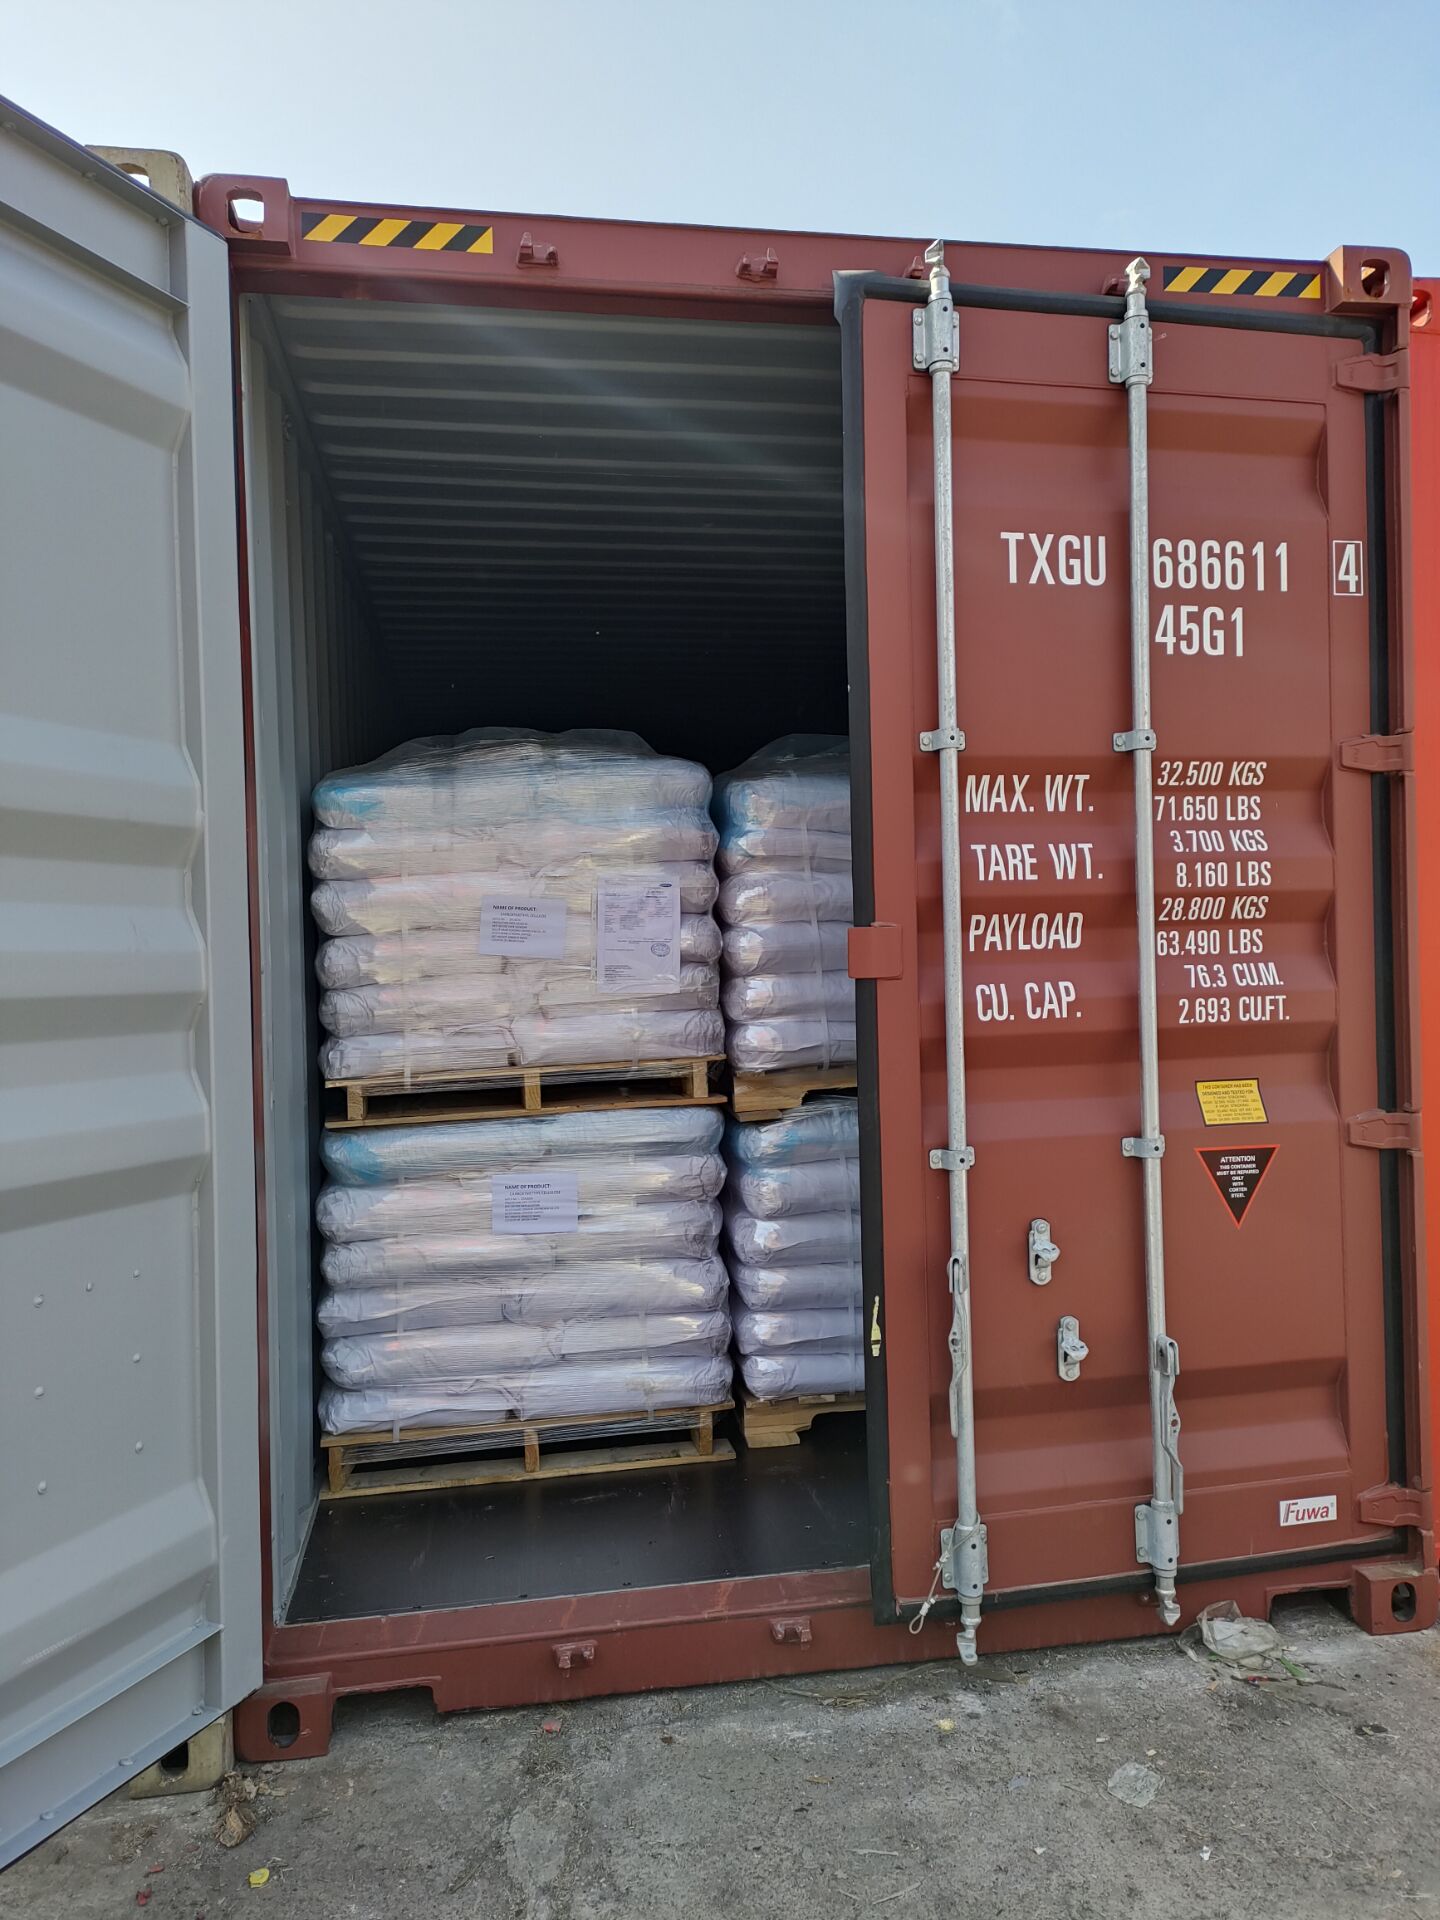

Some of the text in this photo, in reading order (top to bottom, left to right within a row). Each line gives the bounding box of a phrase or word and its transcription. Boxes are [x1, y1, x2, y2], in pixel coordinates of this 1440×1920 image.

[1001, 532, 1358, 592] TXGU 686611 4
[1155, 605, 1243, 656] 45G1
[1229, 762, 1266, 785] KGS
[966, 775, 1093, 812] MAX. WT.
[1227, 796, 1260, 820] LBS
[1229, 830, 1268, 851] KGS
[971, 843, 1102, 880] TARE WT.
[1237, 861, 1271, 886] LBS
[1231, 896, 1268, 919] KGS
[970, 913, 1083, 951] PAYLOAD
[1229, 929, 1263, 954] LBS
[1184, 964, 1227, 988] 76.3
[976, 981, 1081, 1021] CU. CAP.
[1220, 1155, 1256, 1163] ATTENTION
[1282, 1501, 1330, 1523] Fuwa
